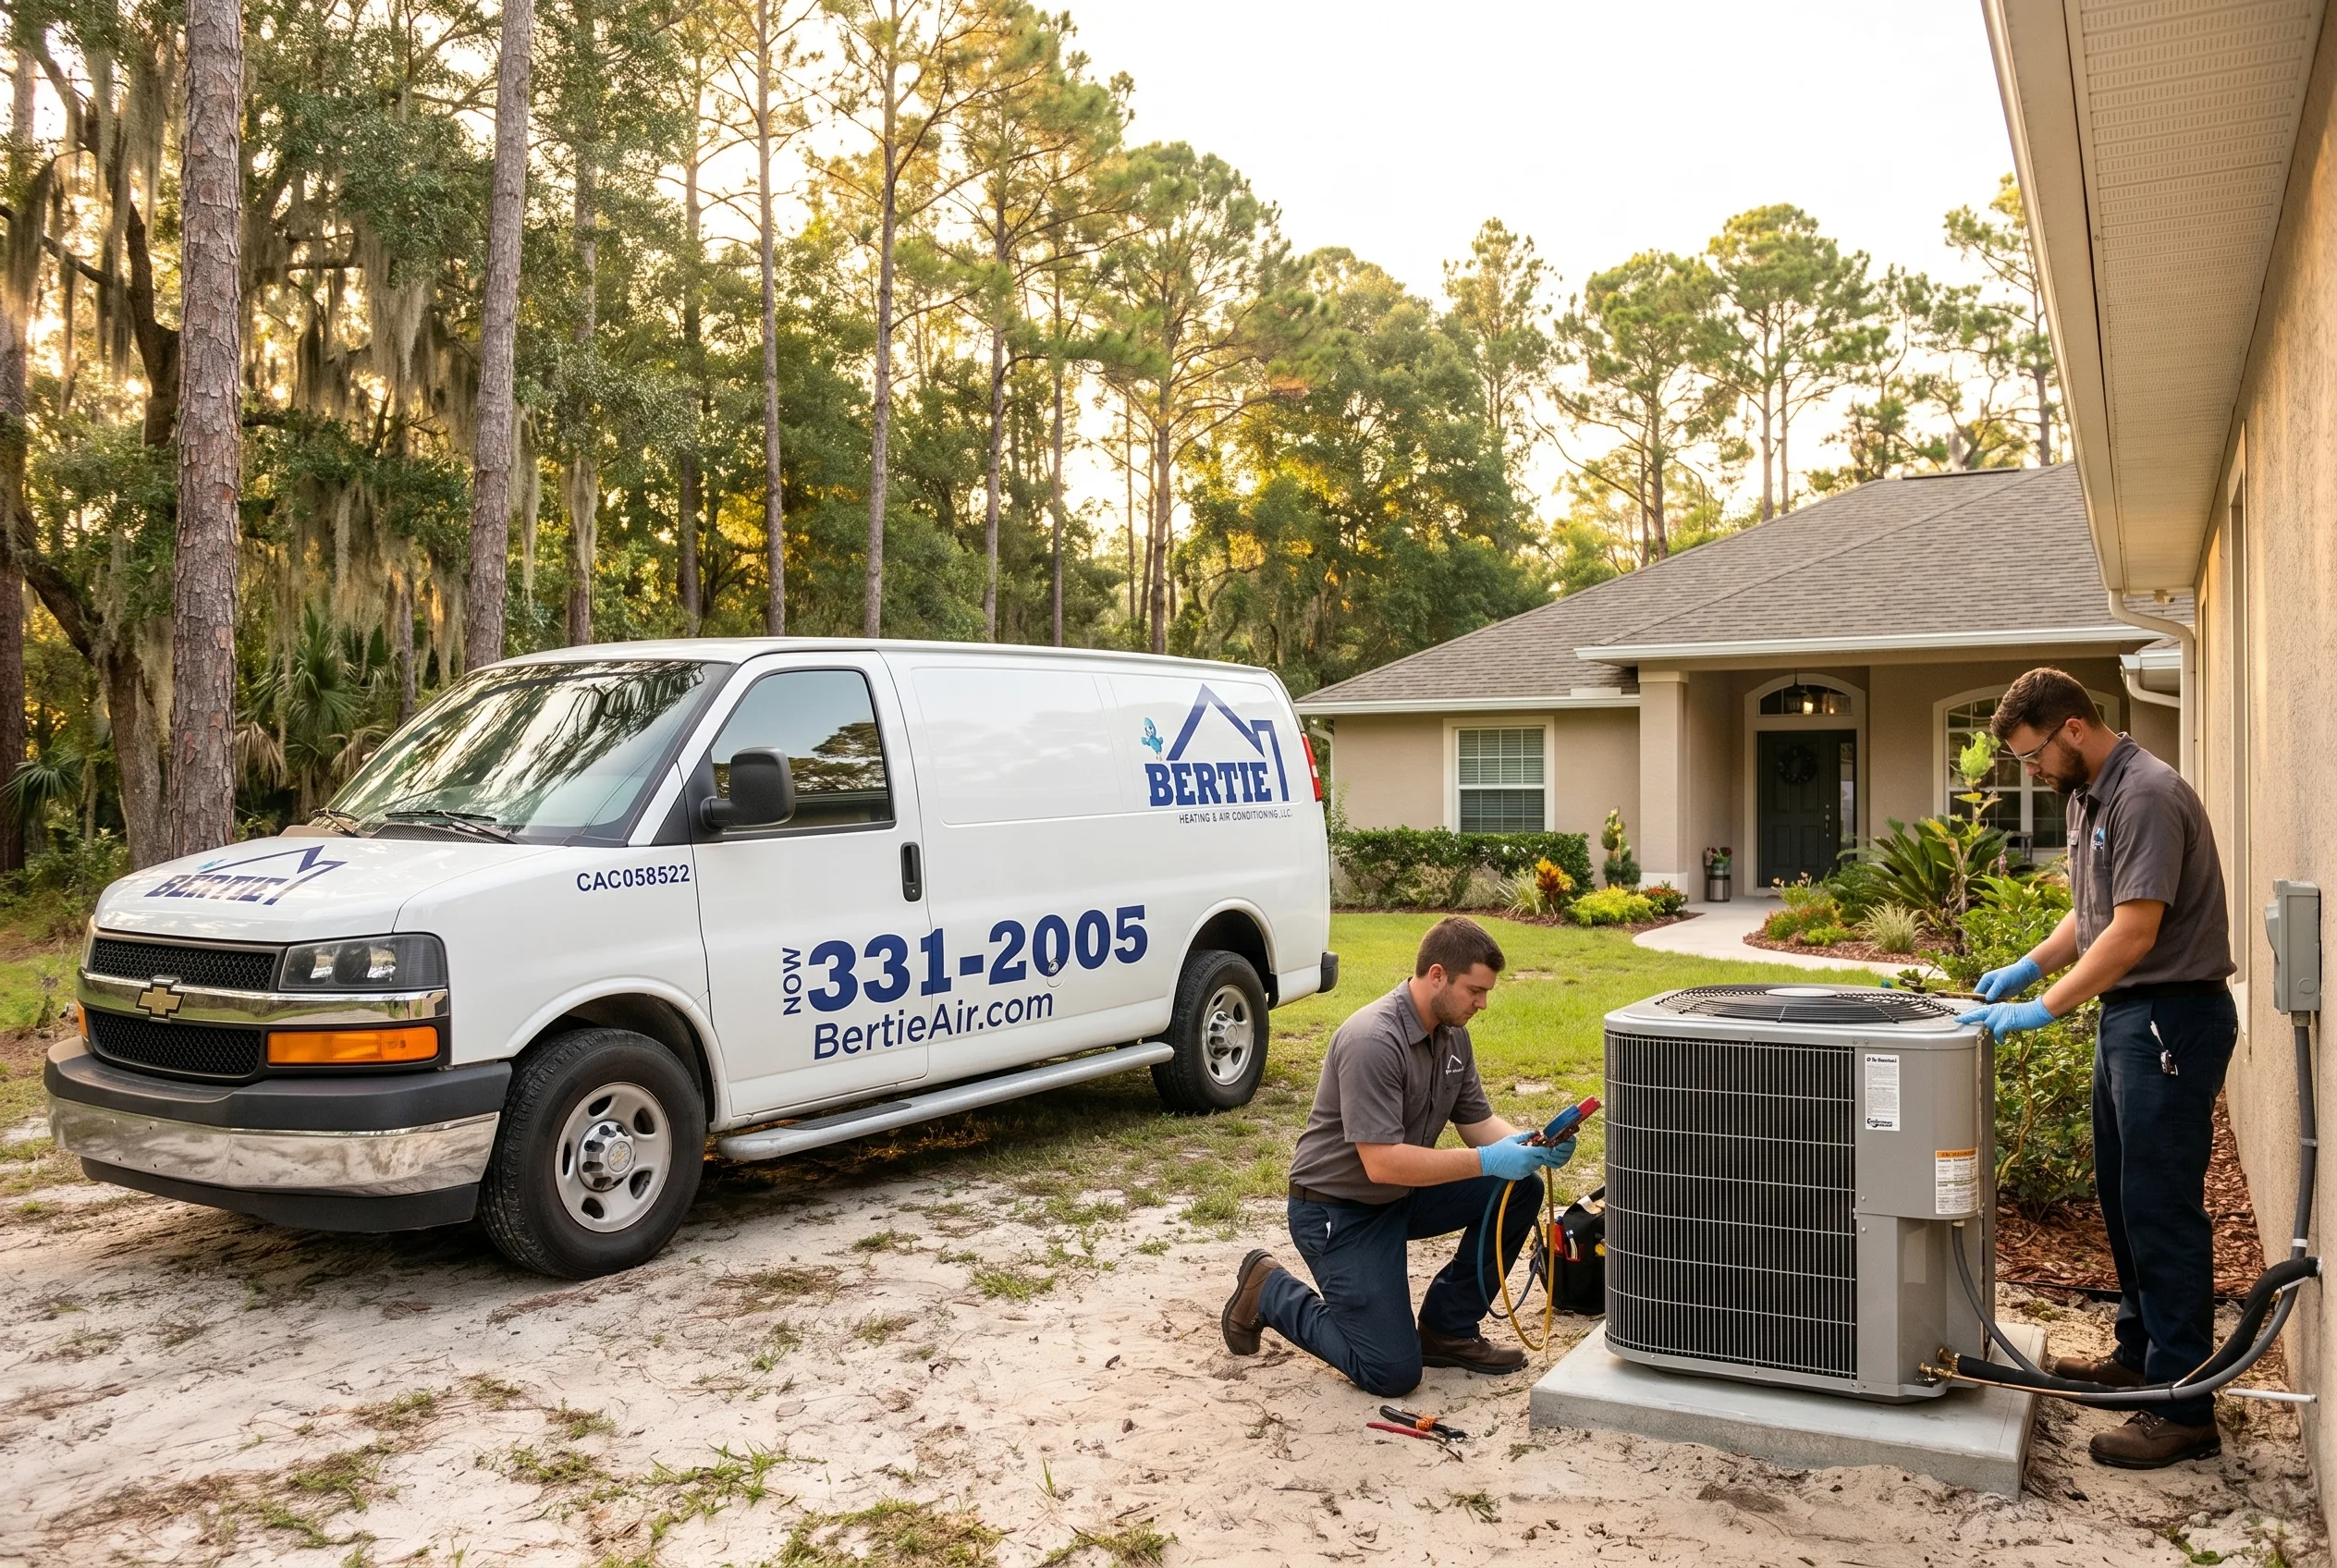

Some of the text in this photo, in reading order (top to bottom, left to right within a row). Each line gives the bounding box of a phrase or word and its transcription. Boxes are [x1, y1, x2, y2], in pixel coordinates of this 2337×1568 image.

[1144, 762, 1272, 807] BERTIE
[1179, 813, 1210, 824] HEATING
[1213, 812, 1217, 822] &
[1219, 812, 1230, 822] AIR
[143, 875, 289, 901] BERTIE
[577, 864, 690, 891] CAC058522
[782, 947, 801, 1015] NOW
[807, 905, 1148, 1012] 331-2005
[814, 993, 1053, 1060] BertieAir.com
